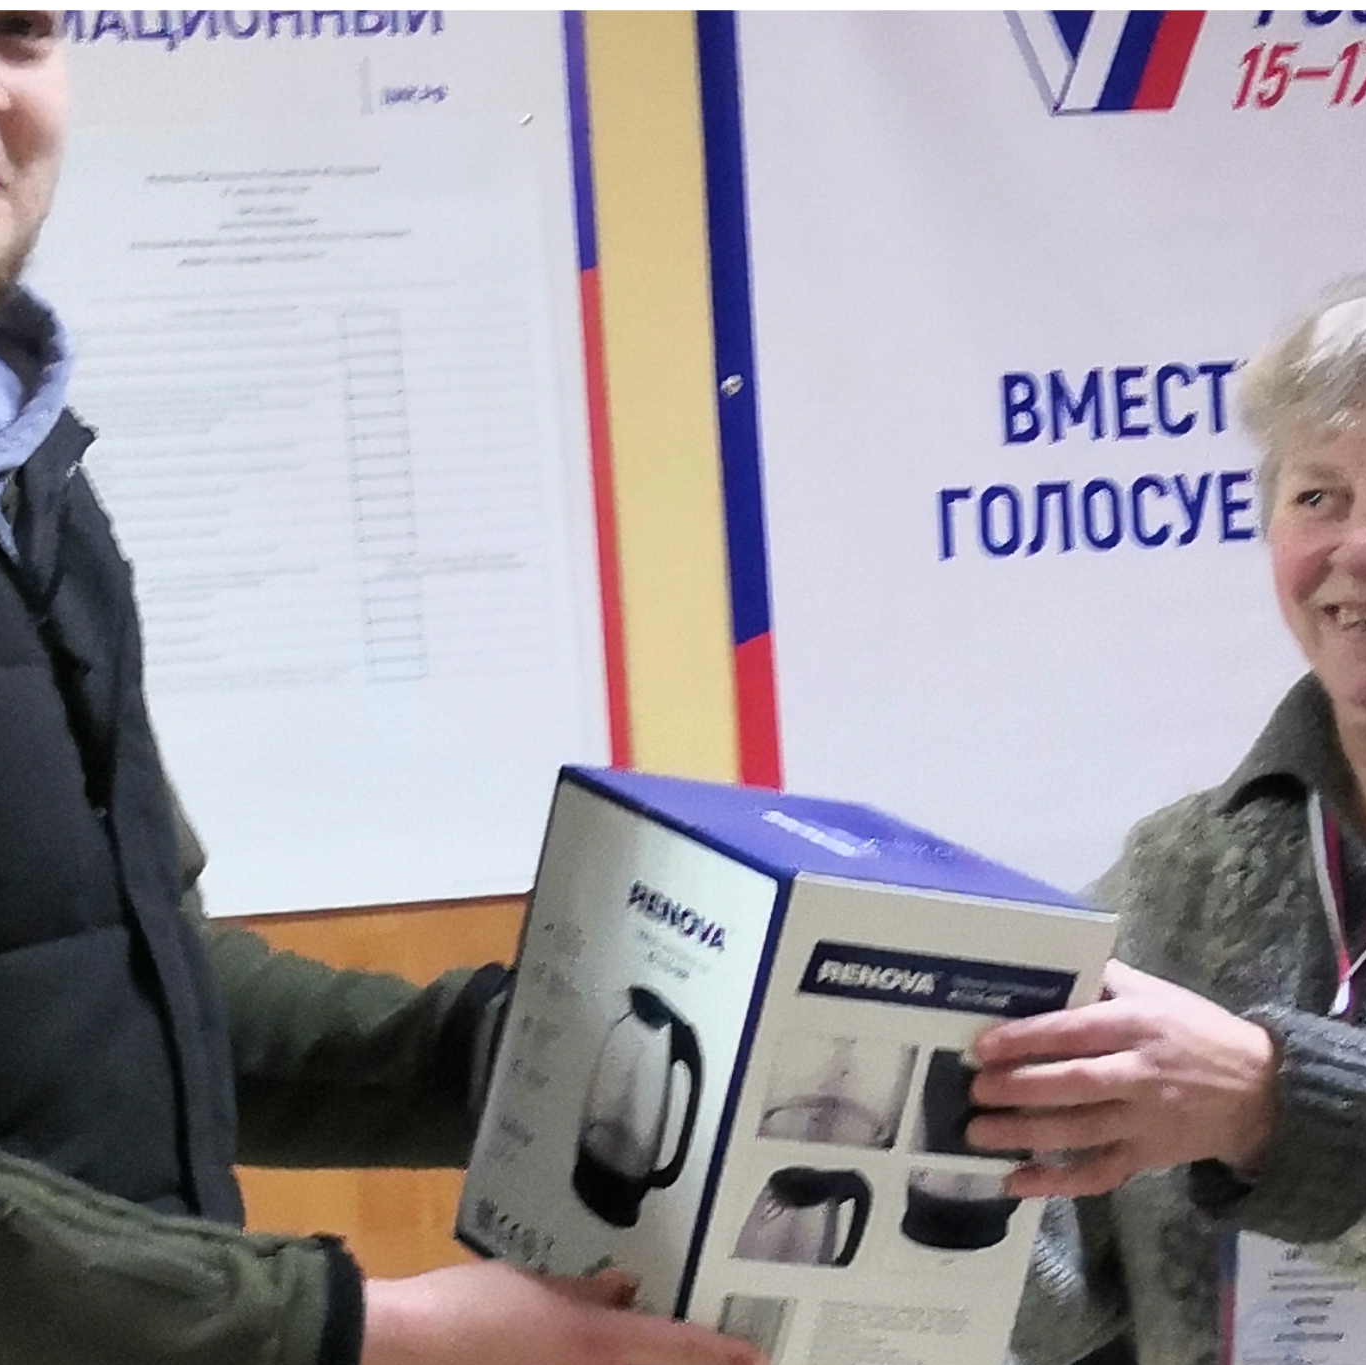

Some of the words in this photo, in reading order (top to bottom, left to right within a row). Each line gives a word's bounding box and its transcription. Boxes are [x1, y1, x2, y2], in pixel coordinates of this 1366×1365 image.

[1000, 358, 1241, 446] ВМЕСТ
[937, 466, 1257, 562] ГОЛОСУЕ
[627, 880, 725, 952] RENOVA
[815, 958, 936, 996] RENOVA
